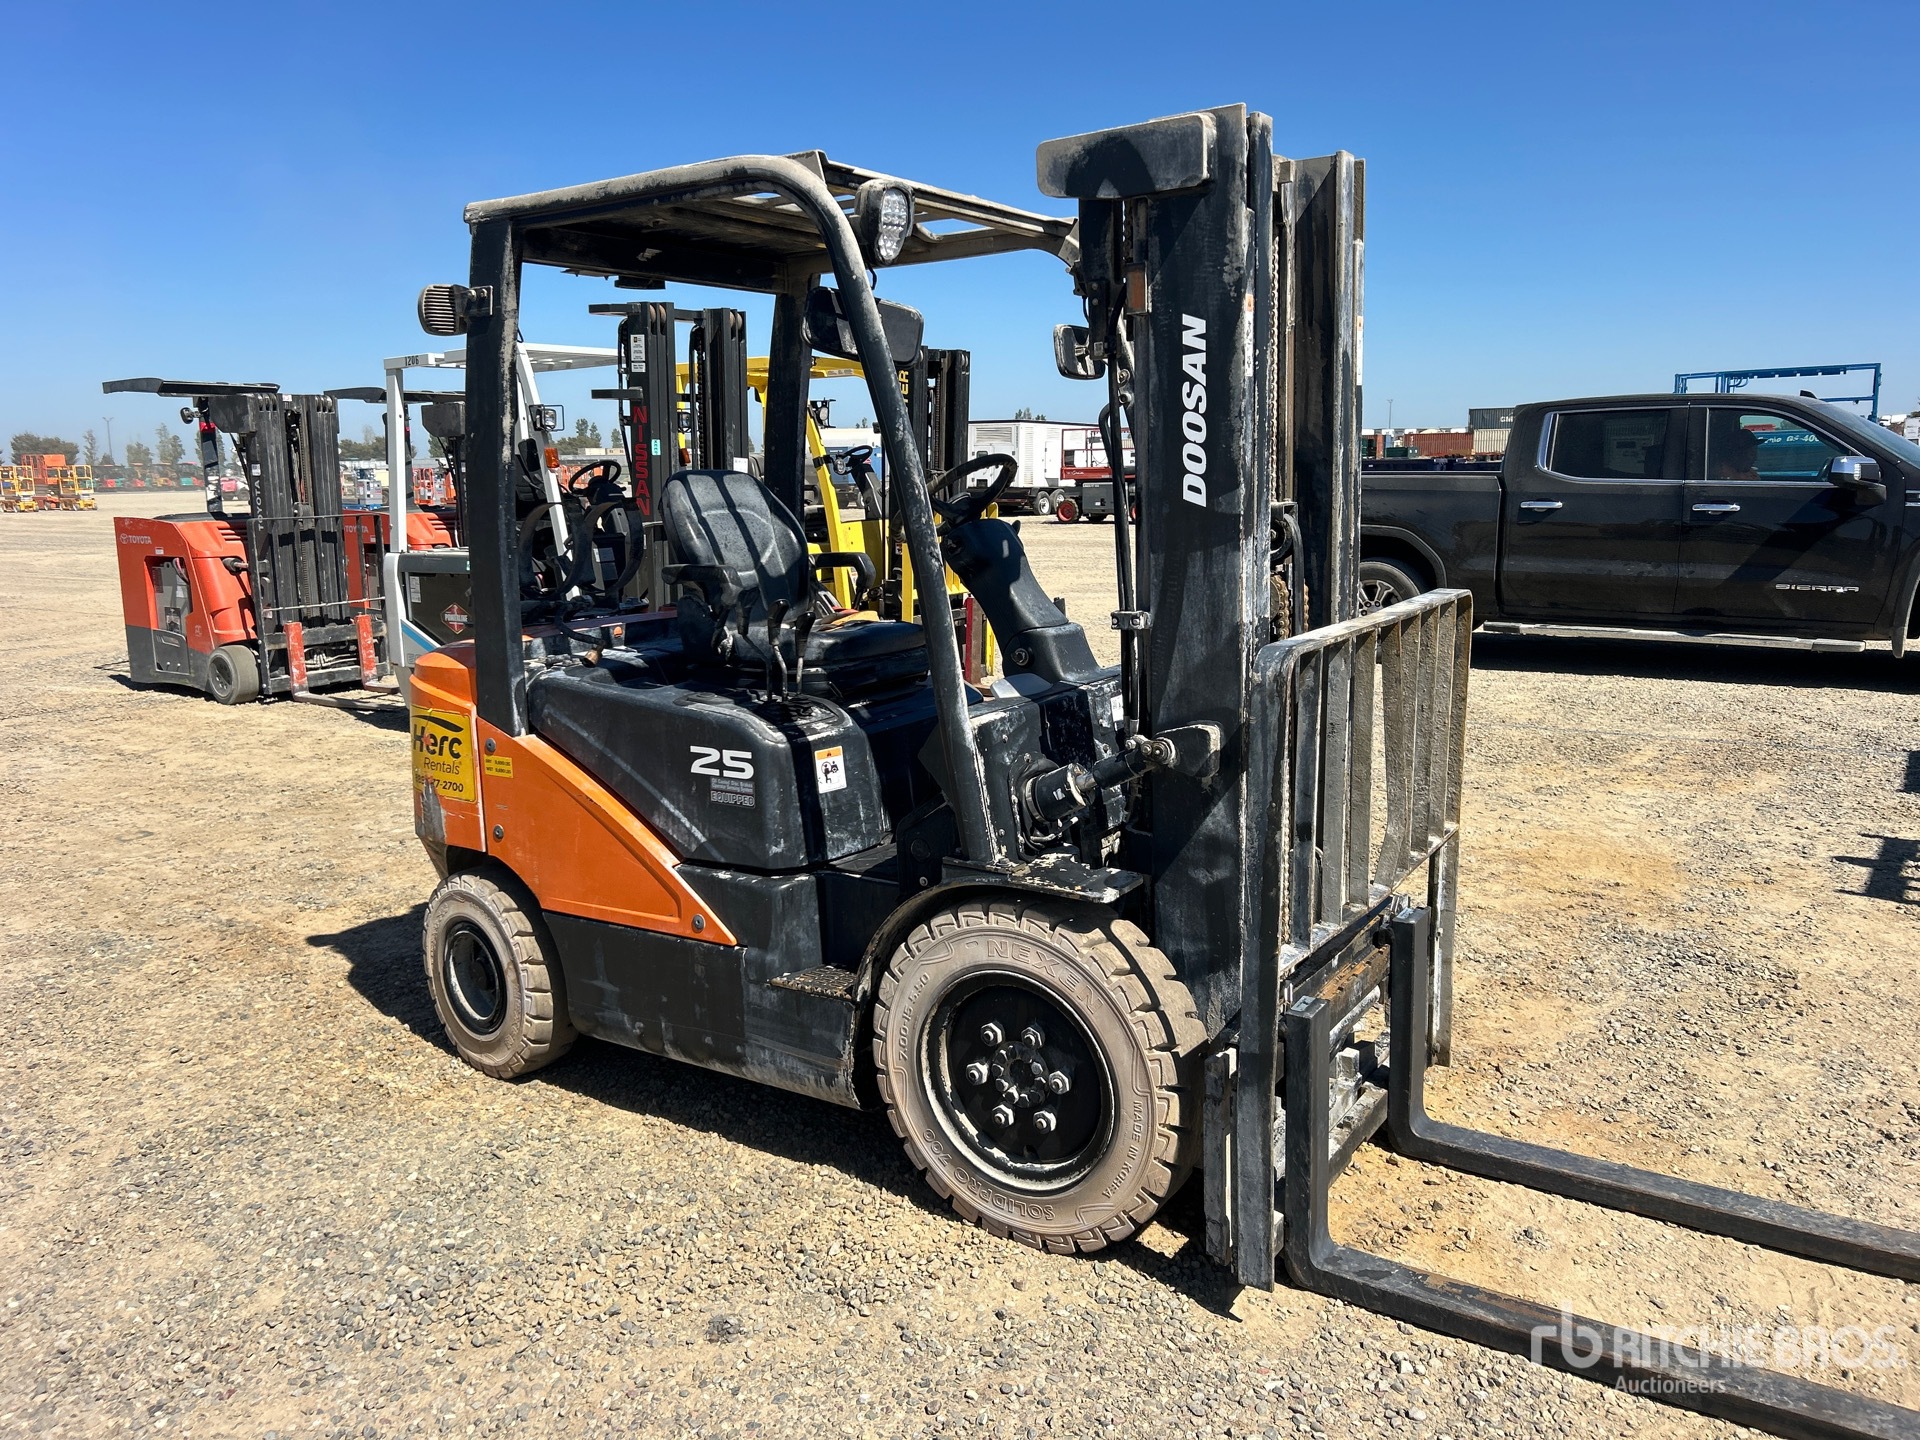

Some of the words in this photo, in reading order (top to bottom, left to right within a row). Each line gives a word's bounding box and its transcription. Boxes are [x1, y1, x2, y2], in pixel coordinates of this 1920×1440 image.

[1182, 313, 1207, 508] DOOSAN
[633, 405, 651, 516] NISSAN
[254, 480, 264, 532] TOYOTA
[128, 535, 153, 545] TOYOTA
[343, 525, 369, 534] TOYTA
[1775, 584, 1860, 593] SIERRA
[413, 723, 463, 760] Herc
[424, 757, 461, 775] Rentals
[690, 745, 754, 779] 25
[711, 790, 755, 806] EQUIPPED
[987, 939, 1104, 1015] NEXEN
[1131, 1100, 1144, 1143] MADE
[922, 1128, 953, 1168] 700
[1126, 1144, 1139, 1161] IN
[953, 1166, 1056, 1221] SOLIDPRO
[1101, 1161, 1133, 1199] KOREA
